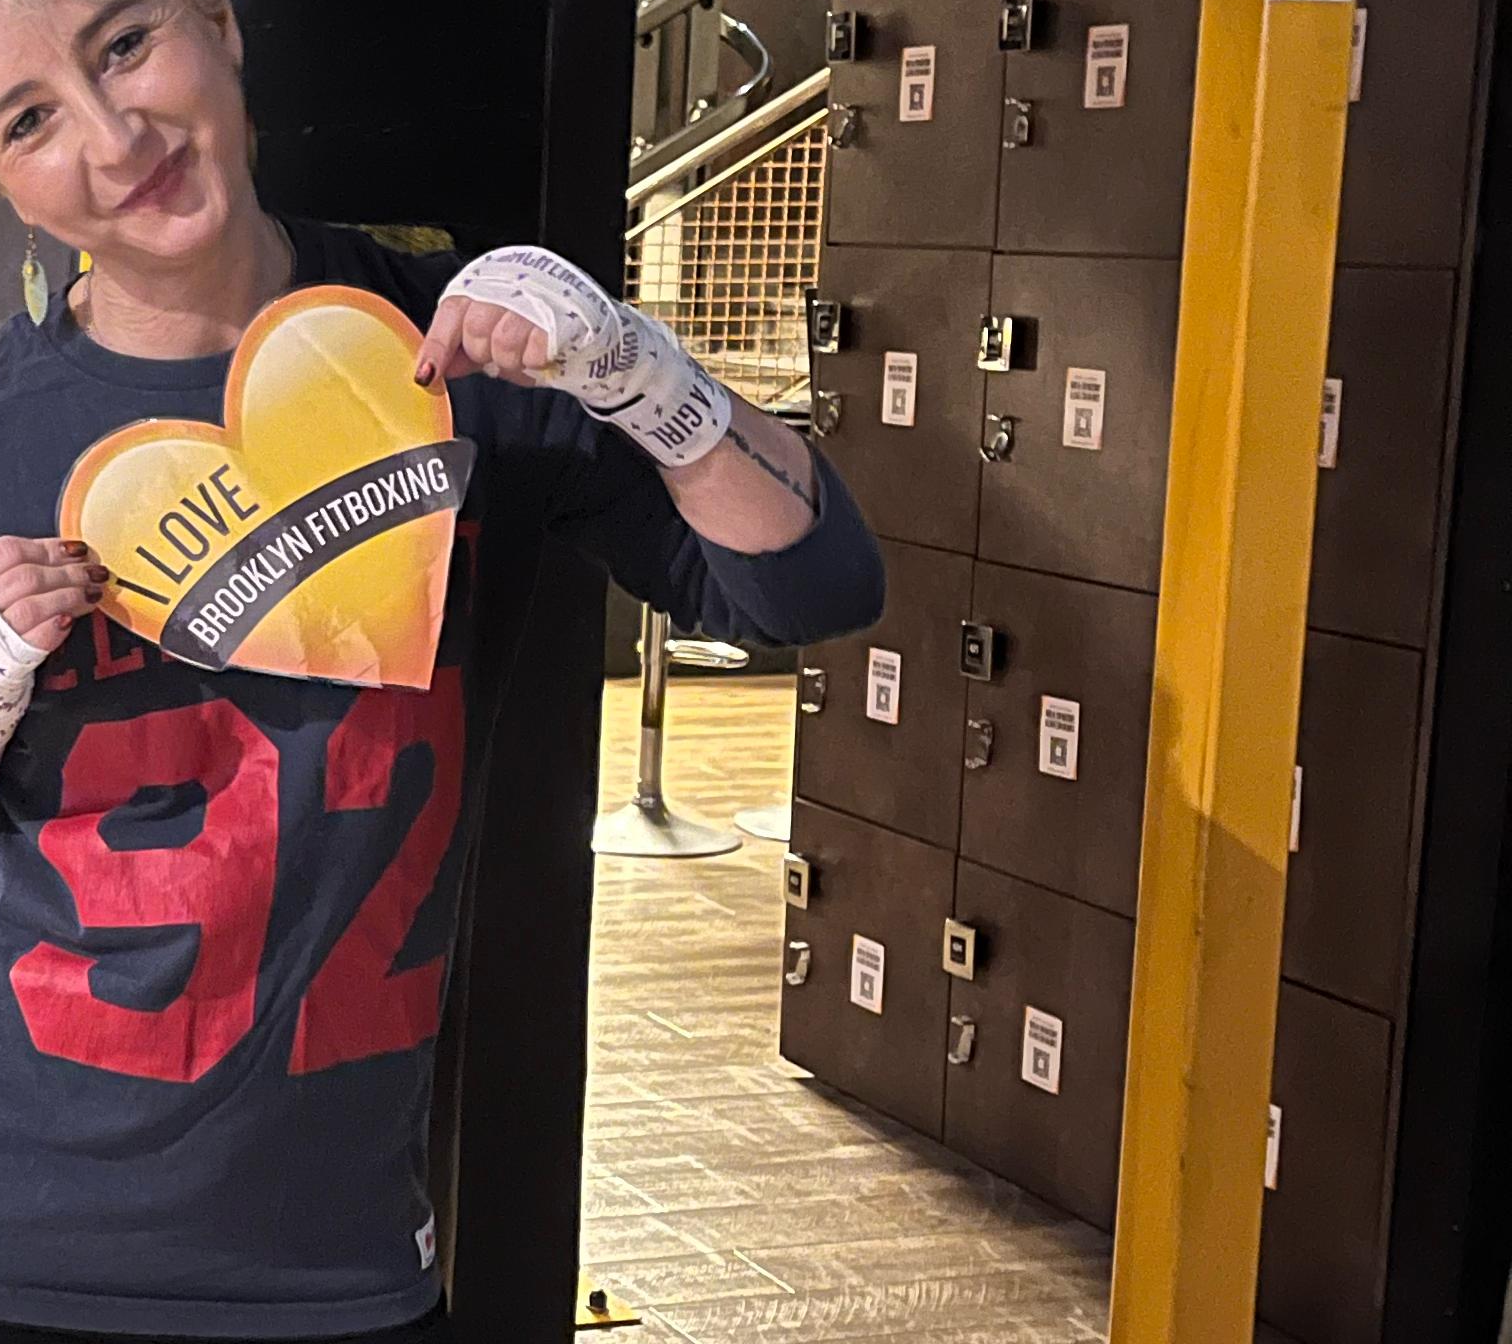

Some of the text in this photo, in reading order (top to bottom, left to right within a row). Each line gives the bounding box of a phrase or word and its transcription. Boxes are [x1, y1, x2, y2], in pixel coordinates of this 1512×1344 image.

[644, 401, 703, 450] GIRL
[689, 383, 712, 409] A
[115, 463, 261, 606] I LOVE
[187, 525, 312, 648] BROOKLYN
[305, 457, 450, 546] FITBOXING
[9, 667, 468, 1083] 92
